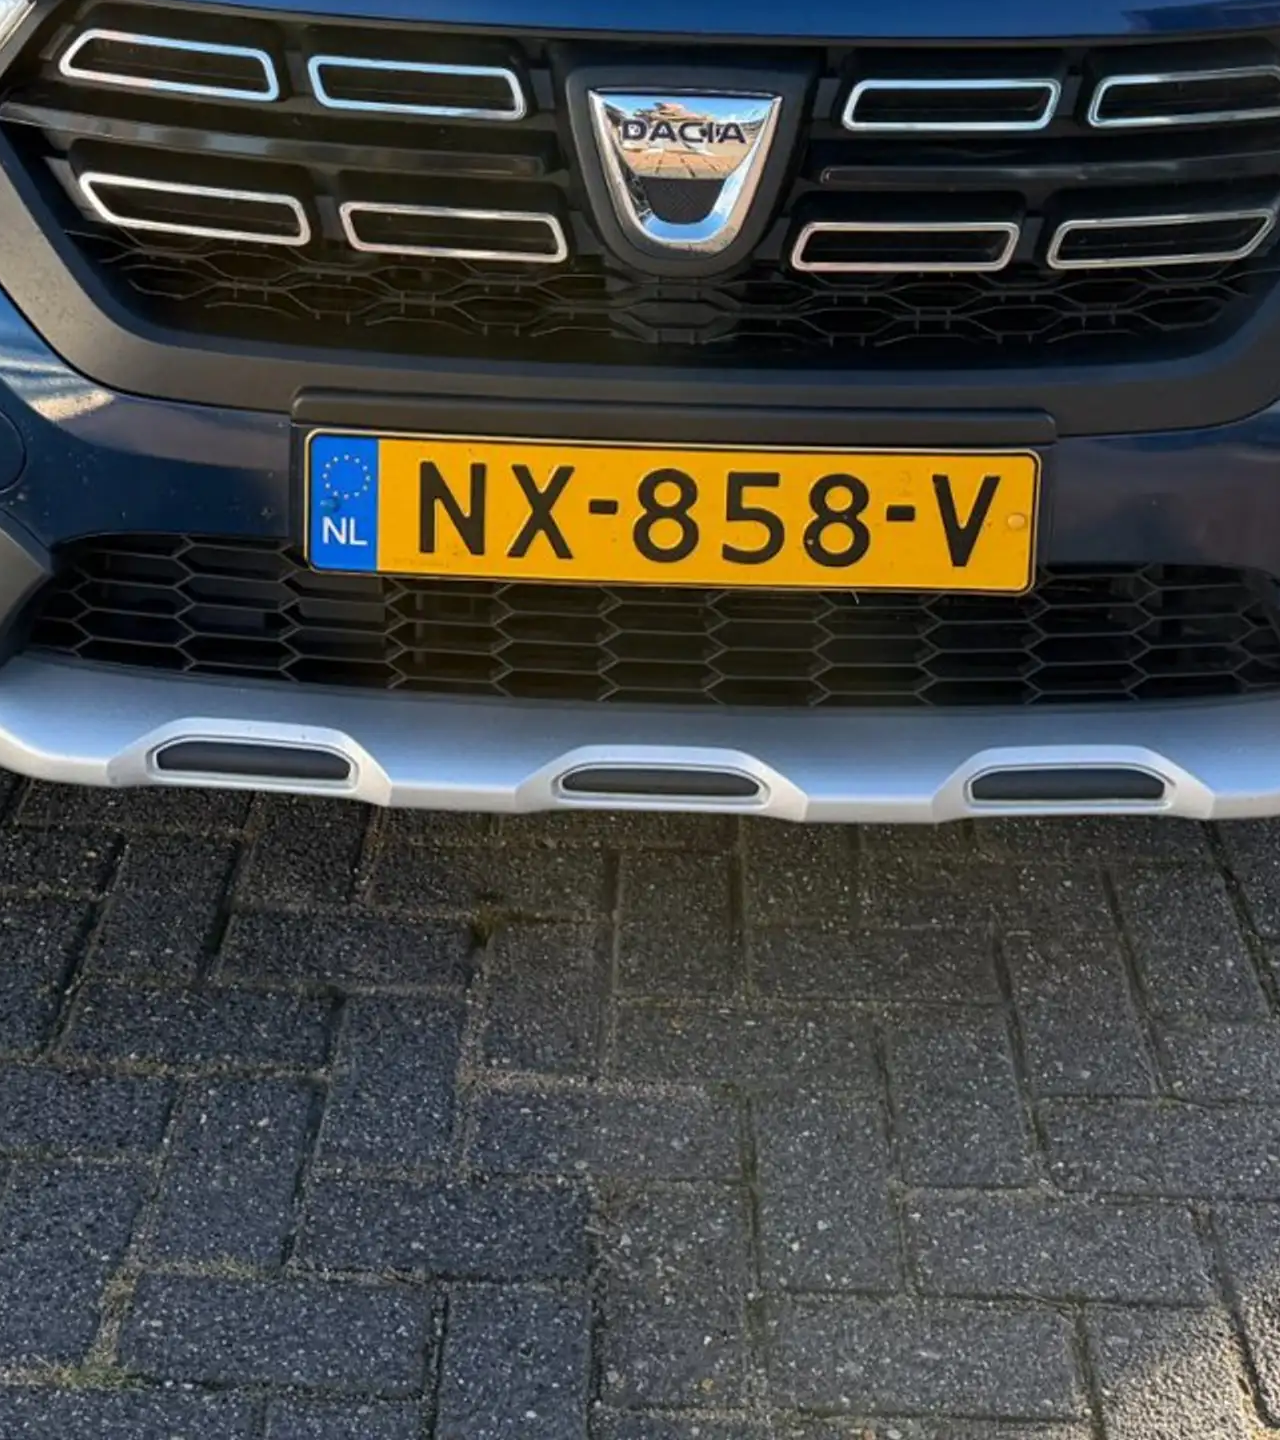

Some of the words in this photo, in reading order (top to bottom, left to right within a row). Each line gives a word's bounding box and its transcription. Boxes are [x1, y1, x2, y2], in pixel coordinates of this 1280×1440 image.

[622, 120, 746, 144] DACIA
[322, 515, 369, 546] NL
[417, 460, 1001, 568] NX-858-V
